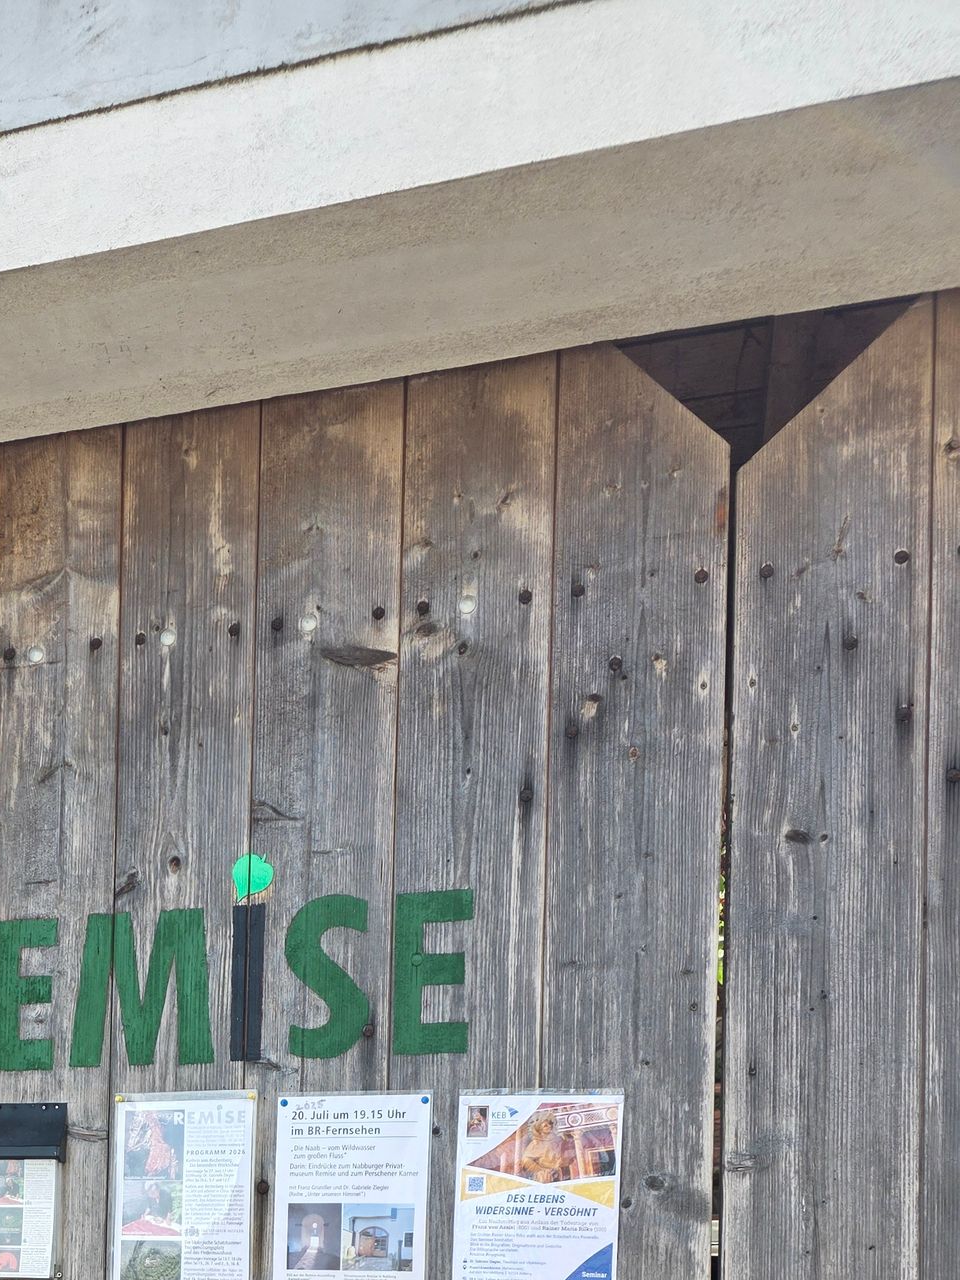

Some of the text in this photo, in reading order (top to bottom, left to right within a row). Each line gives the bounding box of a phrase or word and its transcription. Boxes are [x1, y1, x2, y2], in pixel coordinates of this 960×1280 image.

[173, 1106, 246, 1126] REMISE
[291, 1108, 407, 1121] 20. Juli um 19.15 Uhr
[491, 1111, 507, 1119] KEB
[290, 1124, 381, 1136] im BR-Fernsehen
[304, 1144, 321, 1152] Naab
[341, 1144, 376, 1152] Wildwasser
[186, 1149, 227, 1157] PROGRAMM
[307, 1152, 328, 1161] großen
[308, 1162, 338, 1170] Eindrücke
[352, 1162, 384, 1171] Nabburger
[384, 1162, 406, 1170] Privat-
[314, 1170, 337, 1178] Remise
[337, 1170, 350, 1178] und
[364, 1170, 398, 1178] Perschener
[507, 1193, 566, 1205] DES LEBENS
[475, 1205, 535, 1216] WIDERSINNE
[544, 1205, 599, 1217] VERSÖHNT
[581, 1271, 608, 1279] Seminar
